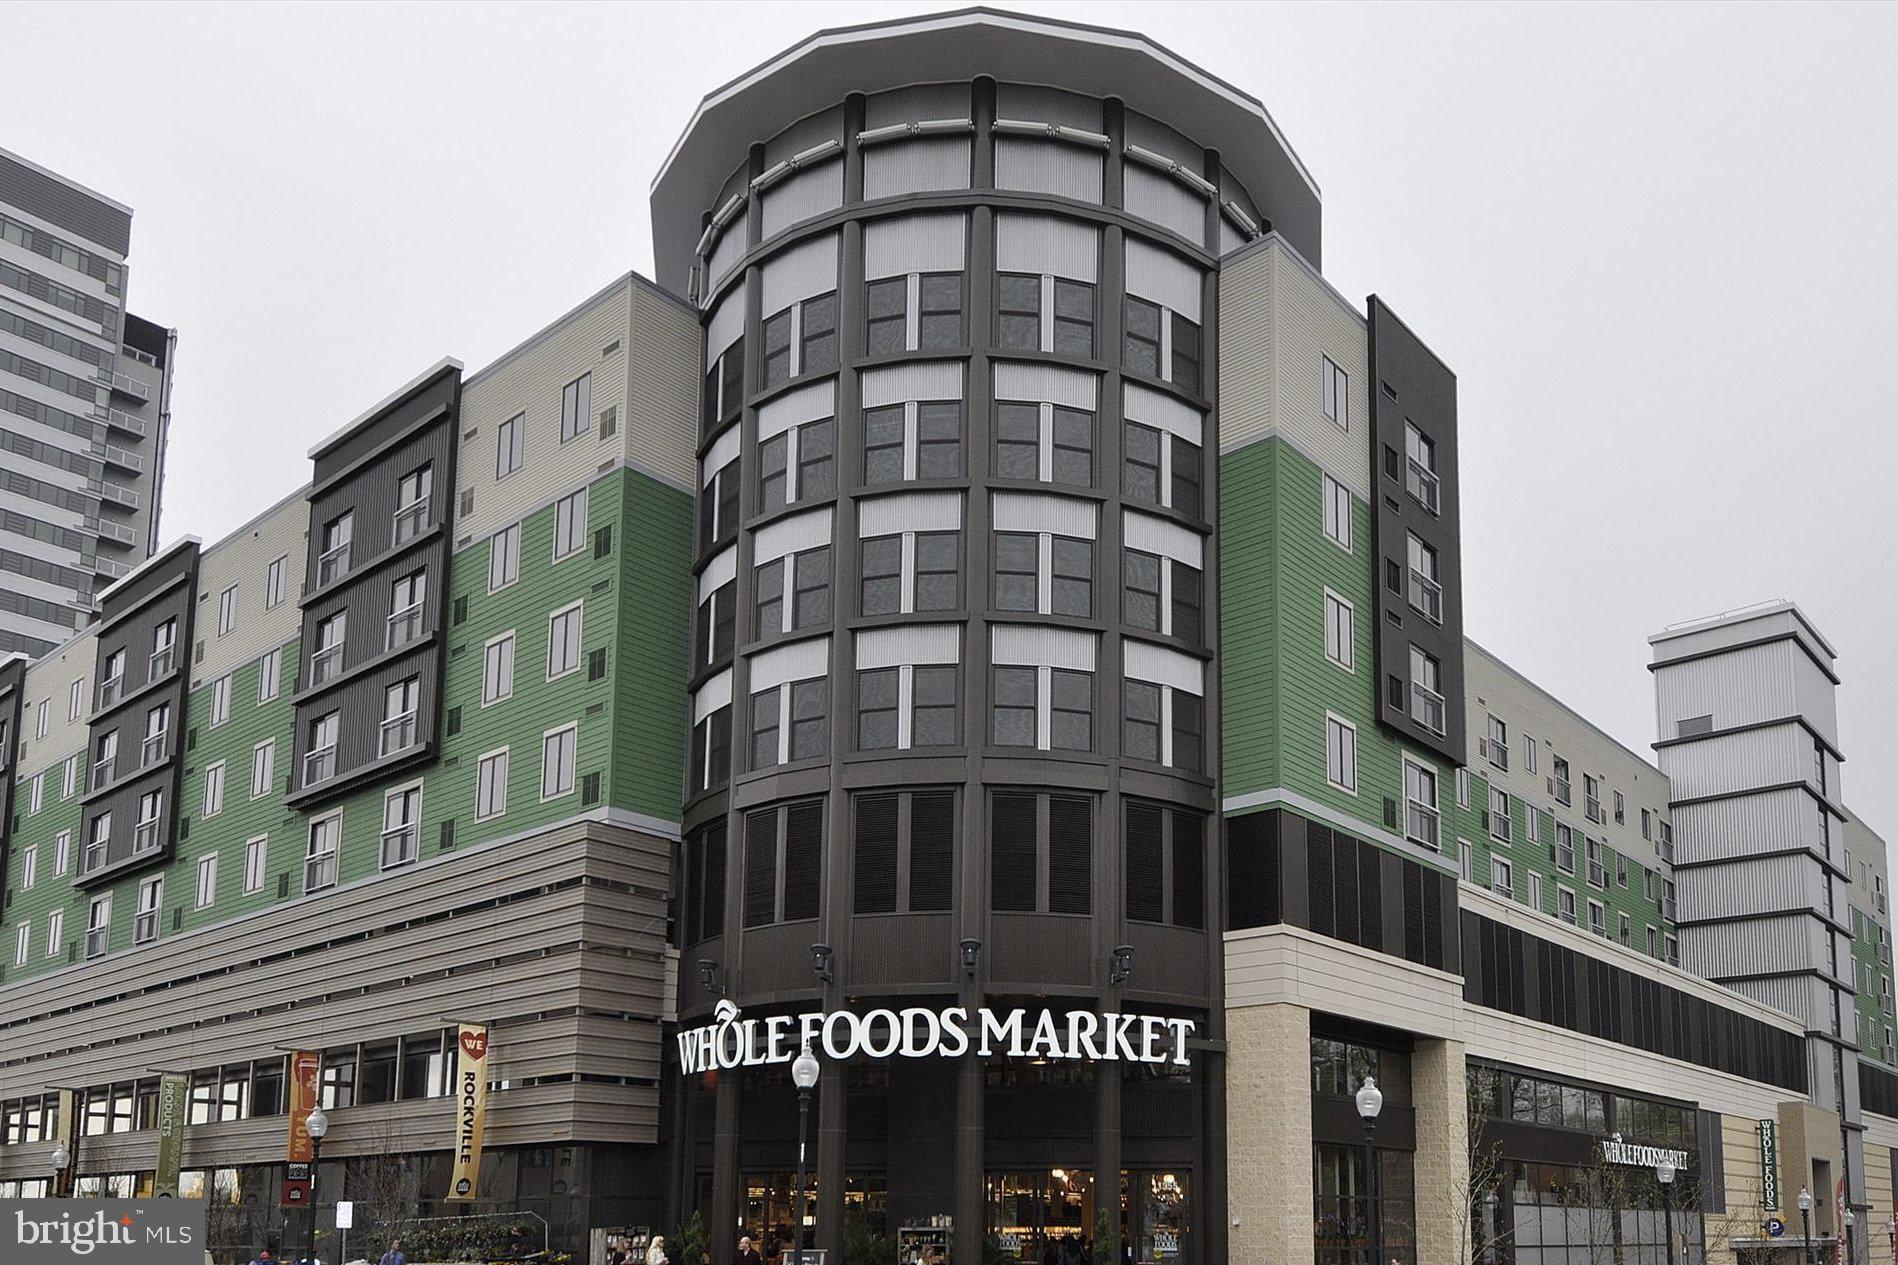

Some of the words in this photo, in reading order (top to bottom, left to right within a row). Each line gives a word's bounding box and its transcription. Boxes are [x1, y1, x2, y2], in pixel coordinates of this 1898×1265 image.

[464, 1039, 484, 1051] WE
[677, 1000, 793, 1076] WHOLE
[798, 1007, 969, 1060] FOODS
[977, 1008, 1196, 1066] MARKET
[162, 1082, 174, 1137] PRODUCTS
[460, 1071, 476, 1164] ROCKVILLE
[1603, 1132, 1634, 1165] WHOLE
[1761, 1120, 1773, 1164] WHOLE
[1765, 1166, 1775, 1207] FOODS
